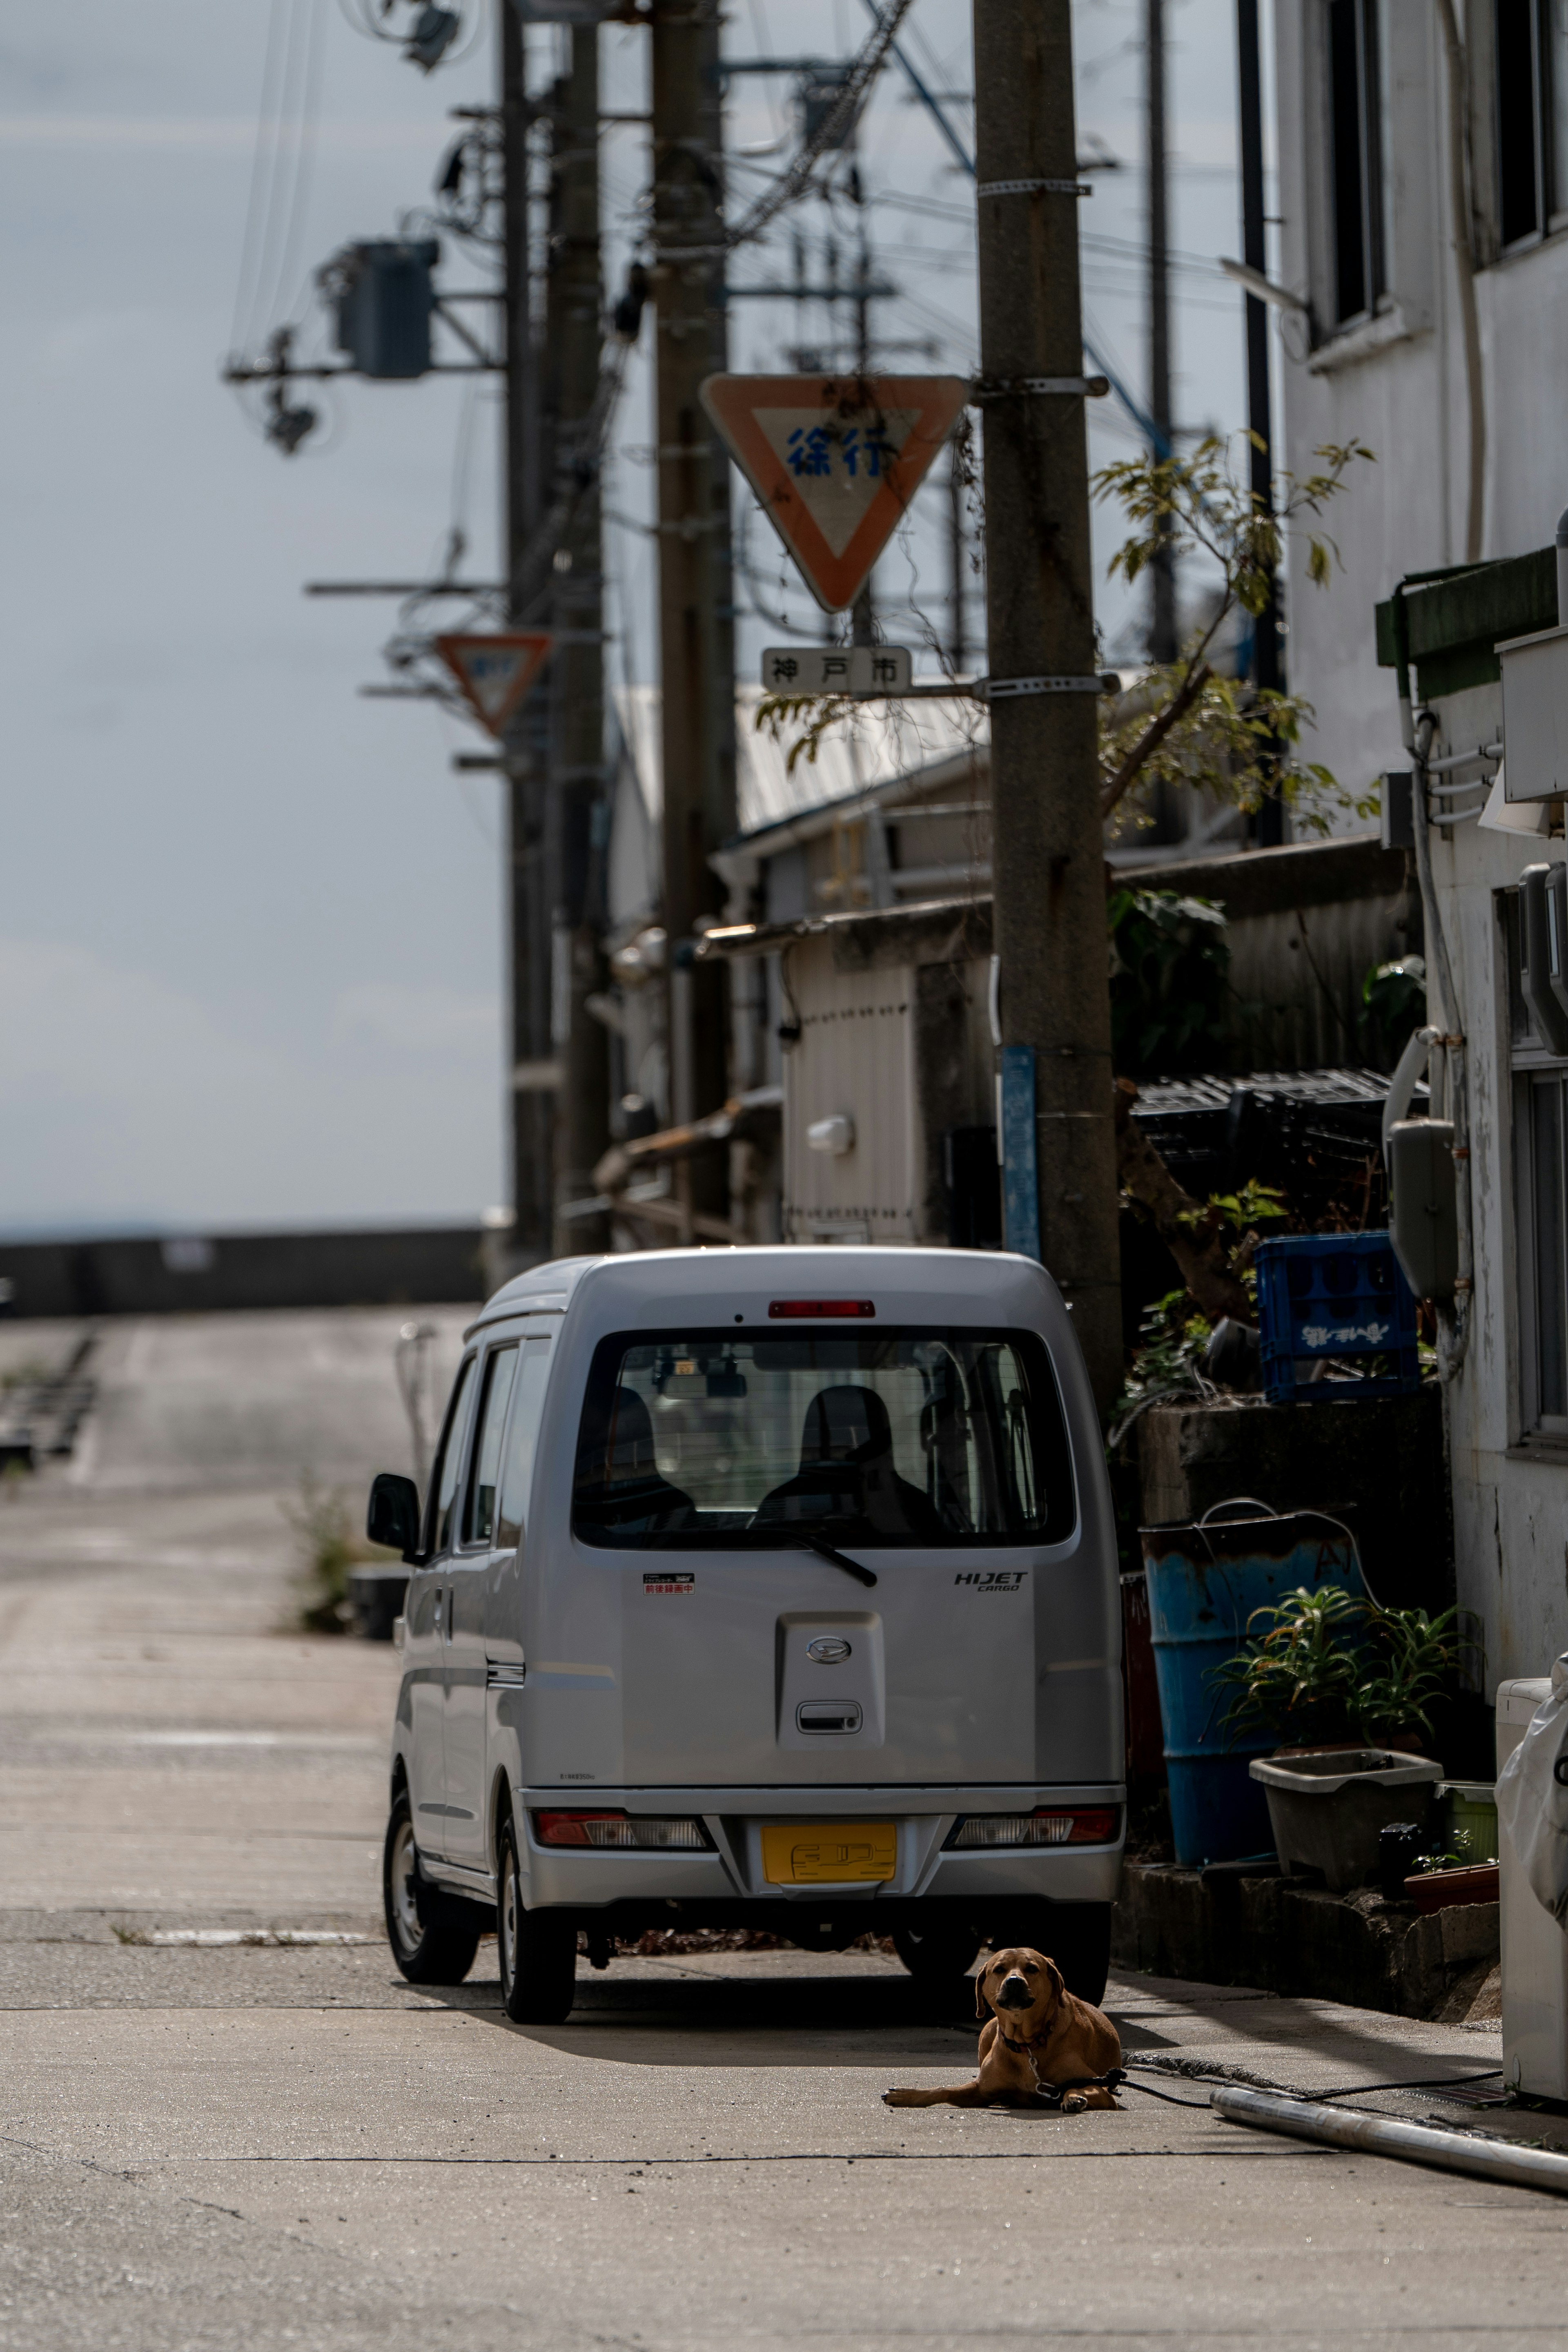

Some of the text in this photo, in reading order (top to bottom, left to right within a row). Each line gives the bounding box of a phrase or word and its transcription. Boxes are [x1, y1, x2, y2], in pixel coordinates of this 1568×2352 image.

[786, 427, 888, 477] 徐行
[773, 657, 898, 683] 神戸市
[954, 1572, 1028, 1585] HIJET
[645, 1585, 693, 1594] 前後録画中
